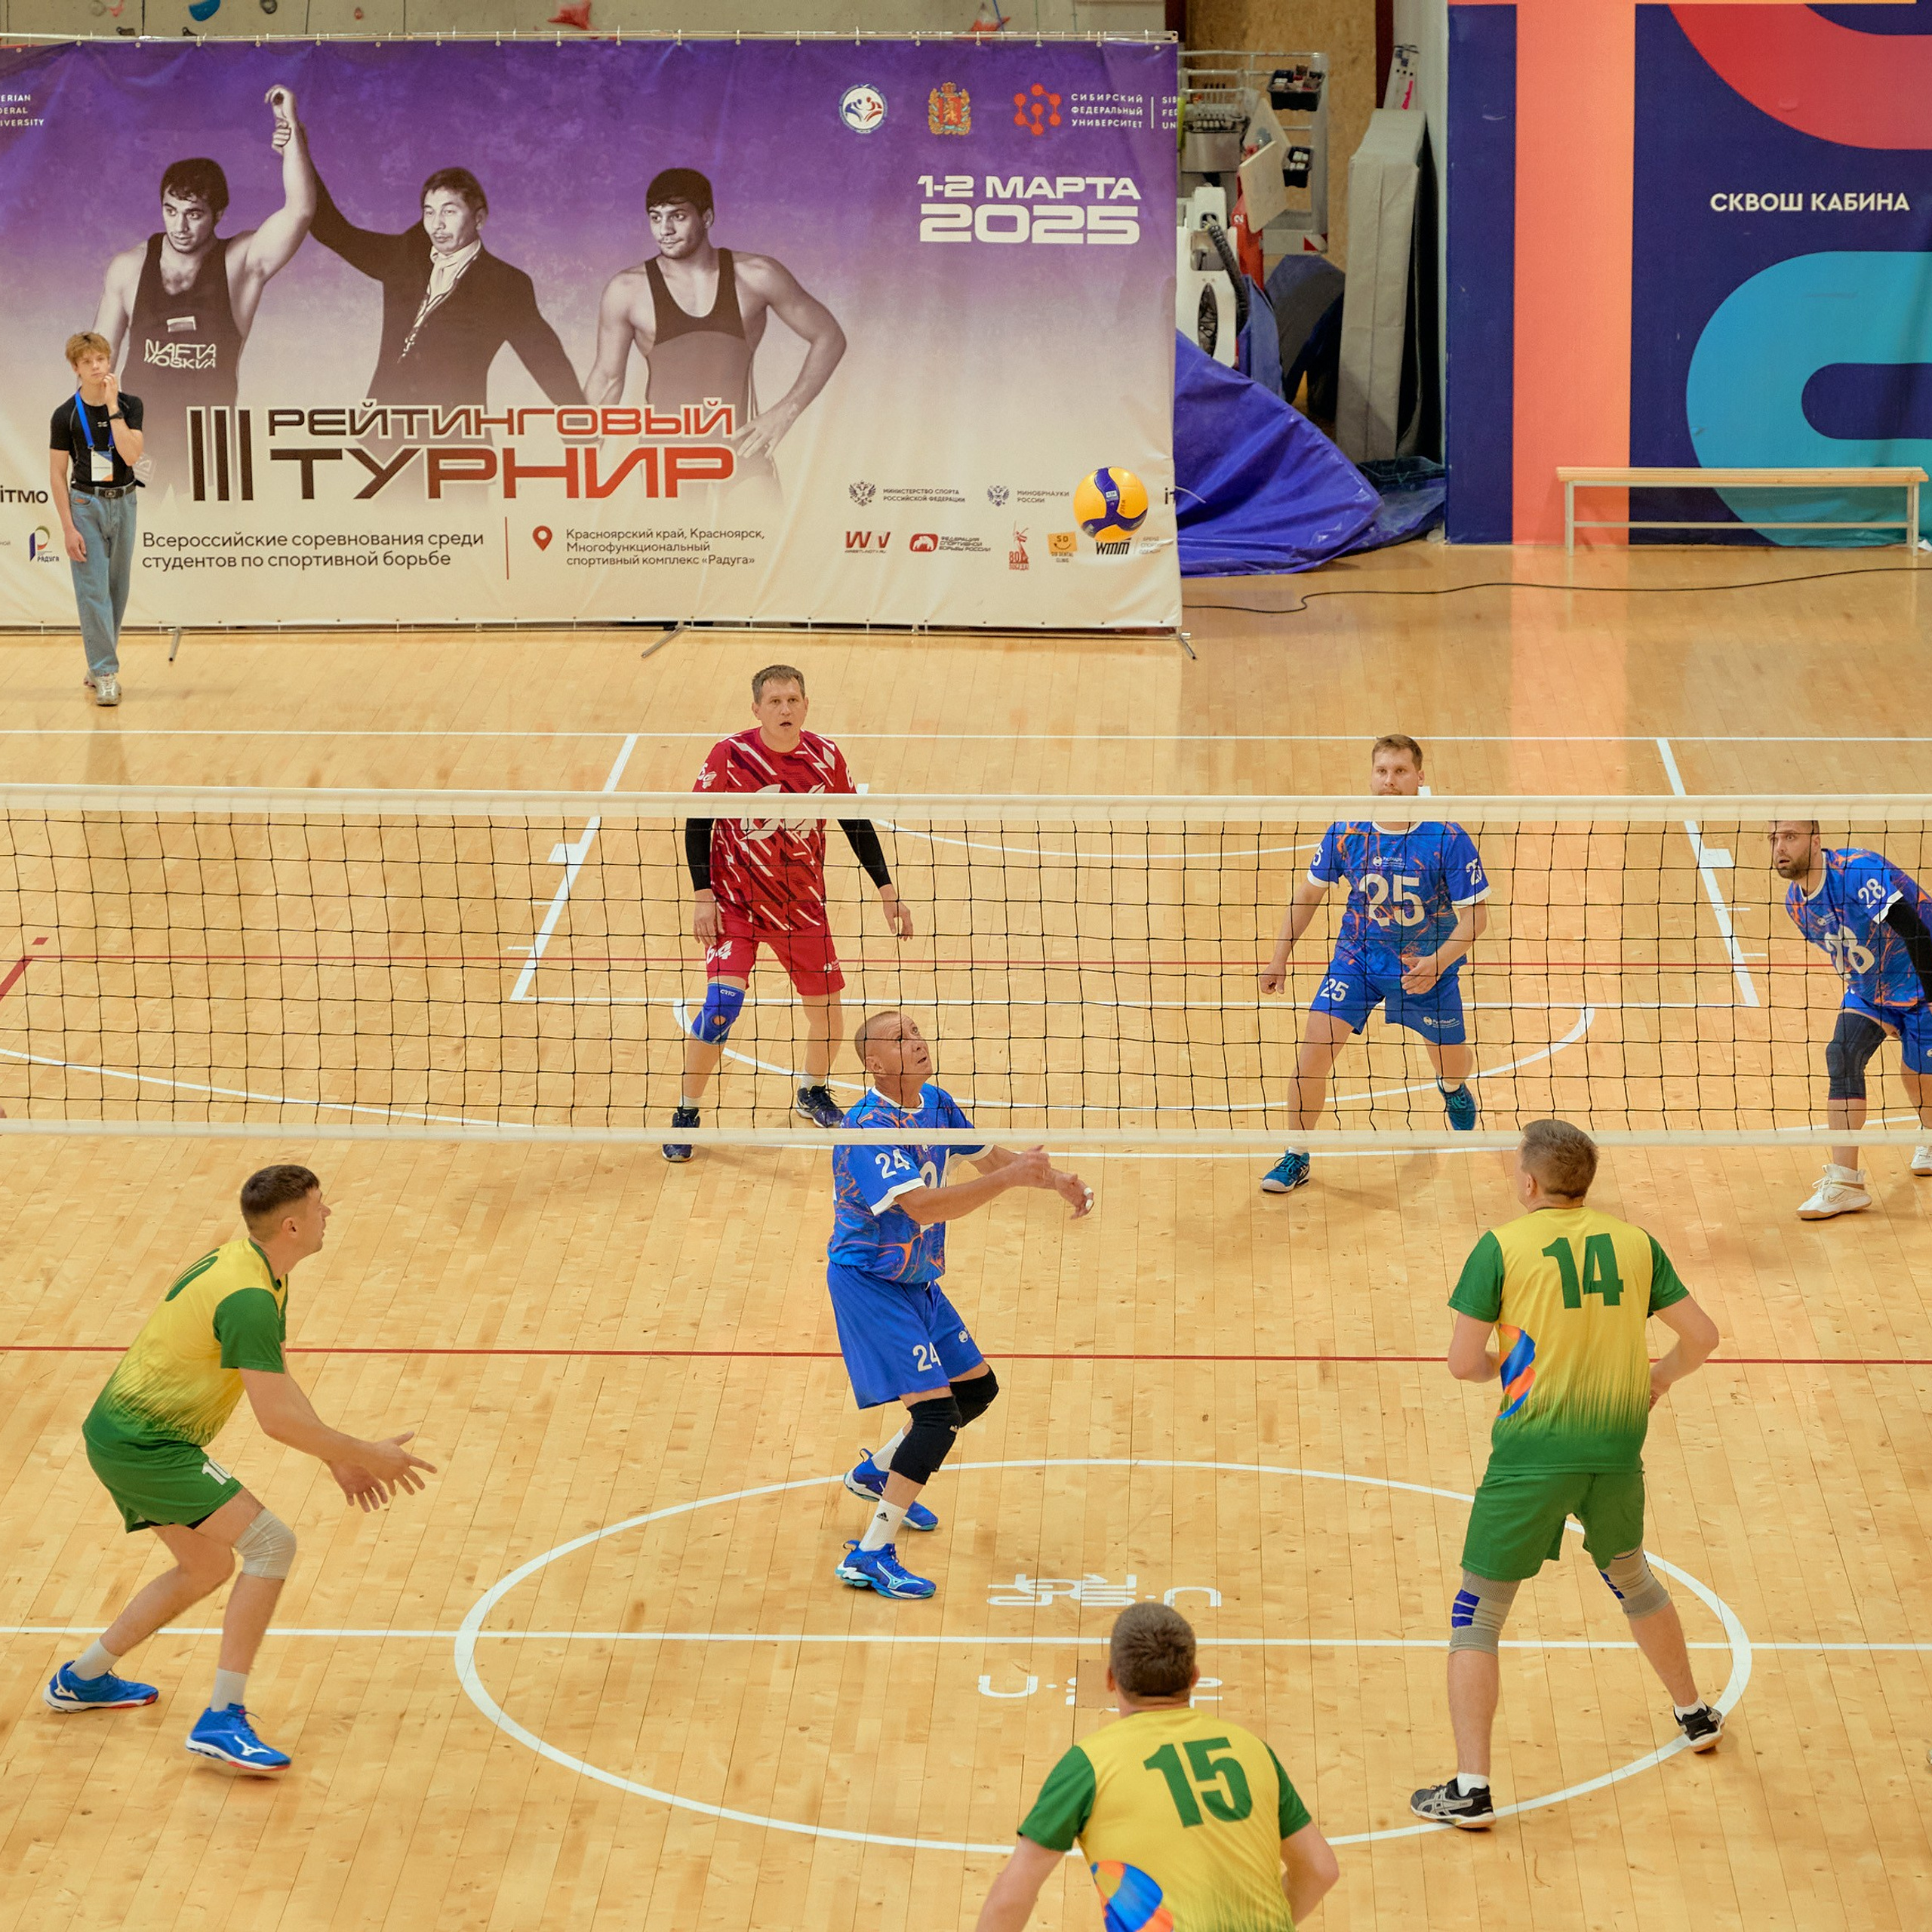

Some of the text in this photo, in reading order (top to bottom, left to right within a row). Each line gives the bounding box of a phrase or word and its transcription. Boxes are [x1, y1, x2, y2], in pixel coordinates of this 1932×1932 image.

[1071, 94, 1143, 103] СИБИРСКИЙ
[1071, 106, 1143, 115] ФЕДЕРАЛЬНЫЙ
[1072, 118, 1143, 128] УНИВЕРСИТЕТ
[917, 175, 1141, 199] 1-2 МАРТА
[1710, 192, 1910, 211] СКВОШ КАБИНА
[919, 203, 1140, 245] 2025
[268, 401, 733, 436] РЕЙТИНГОВЫЙ
[269, 447, 734, 499] ТУРНИР
[143, 532, 484, 550] Всероссийские соревнования среди
[566, 528, 764, 541] Красноярский край, Красноярск,
[567, 541, 710, 554] Многофункциональный
[142, 551, 451, 571] студентов по спортивной борьбе
[566, 555, 755, 567] спортивный комплекс «Радуга»
[1358, 873, 1425, 926] 25
[1858, 878, 1886, 909] 28
[1320, 978, 1349, 1002] 25
[875, 1149, 911, 1179] 24
[1542, 1232, 1624, 1309] 14
[912, 1341, 941, 1372] 24
[1143, 1737, 1253, 1828] 15
